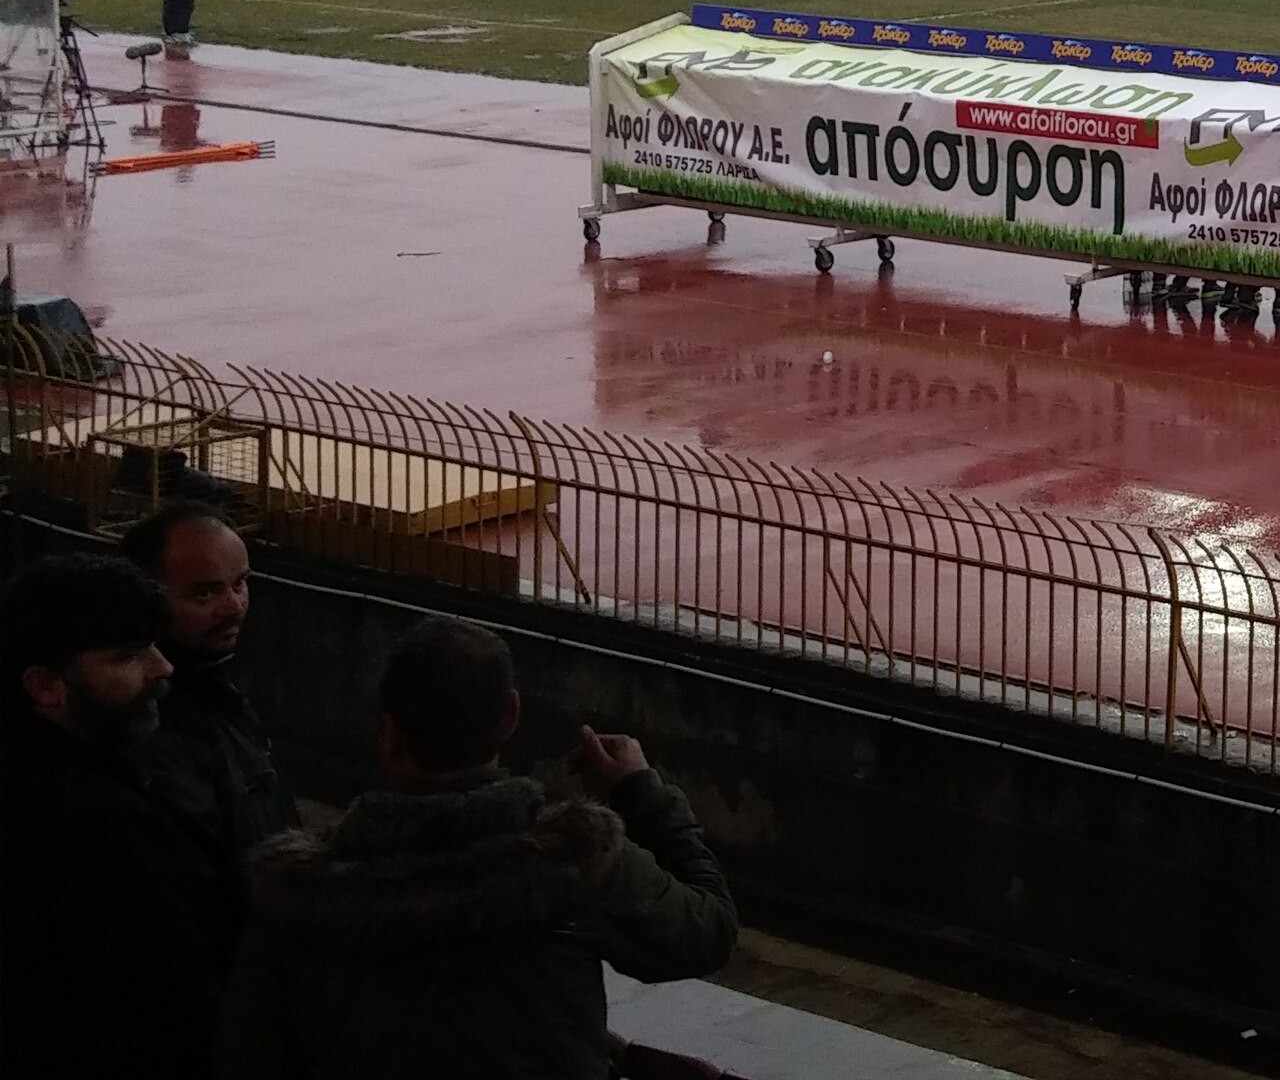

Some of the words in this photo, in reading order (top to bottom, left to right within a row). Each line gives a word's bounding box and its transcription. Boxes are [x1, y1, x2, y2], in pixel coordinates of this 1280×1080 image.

[790, 59, 1194, 134] ανακύκλωση
[657, 111, 745, 158] ΦΛΩΡΟΥ
[747, 124, 790, 164] Α.Ε.
[970, 106, 1137, 145] www.afoiflorou.gr
[634, 149, 662, 167] 2410
[665, 154, 713, 174] 575725
[805, 102, 1125, 235] απόσυρση
[1188, 223, 1226, 241] 2410
